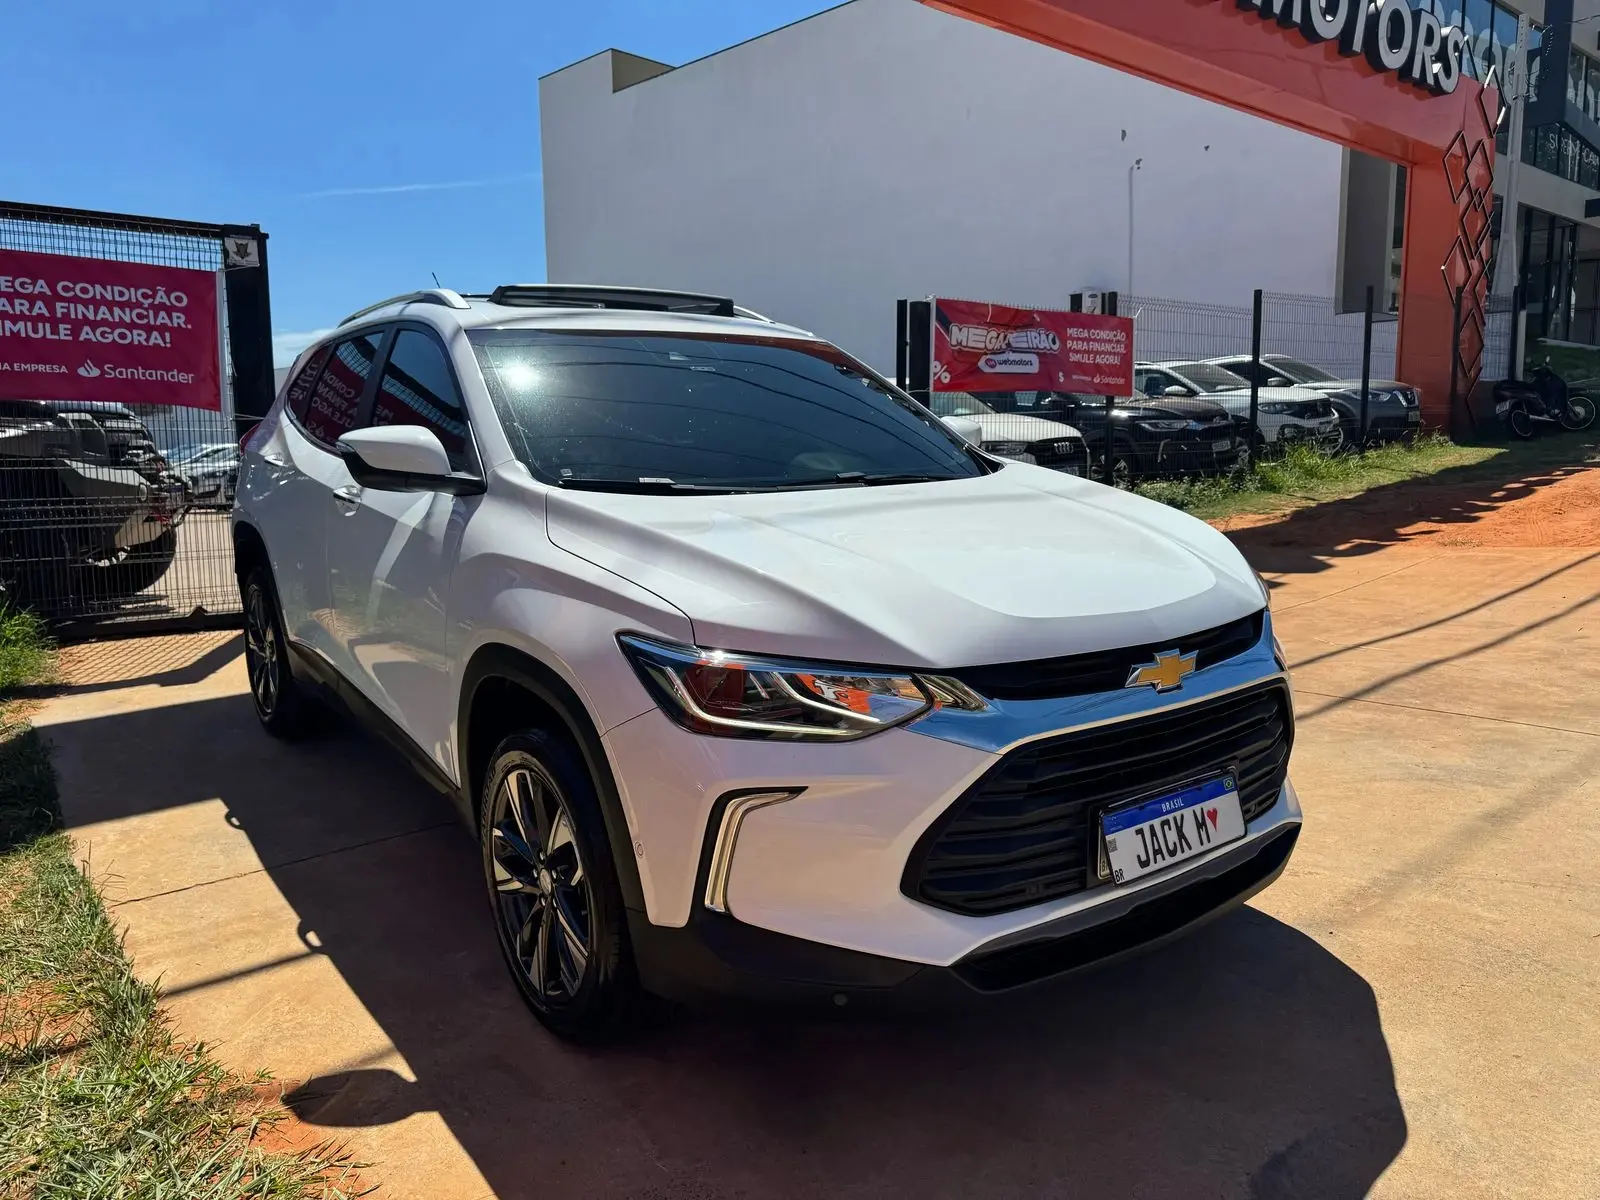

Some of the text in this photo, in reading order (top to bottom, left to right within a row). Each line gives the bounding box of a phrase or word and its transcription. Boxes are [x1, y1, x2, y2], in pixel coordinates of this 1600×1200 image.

[56, 280, 188, 308] CONDIÇÃO
[55, 302, 192, 329] FINANCIAR.
[78, 325, 171, 347] AGORA!
[1066, 327, 1127, 342] MEGA CONDIÇÃO
[1066, 340, 1088, 351] PARA
[997, 357, 1033, 367] webmotors
[1069, 352, 1121, 365] SIMULE AGORA!
[14, 362, 68, 373] EMPRESA
[104, 363, 194, 384] Santander
[1100, 374, 1126, 385] Santander
[1162, 797, 1184, 812] BRASIL
[1135, 806, 1212, 869] JACK M
[1114, 868, 1125, 883] BR
